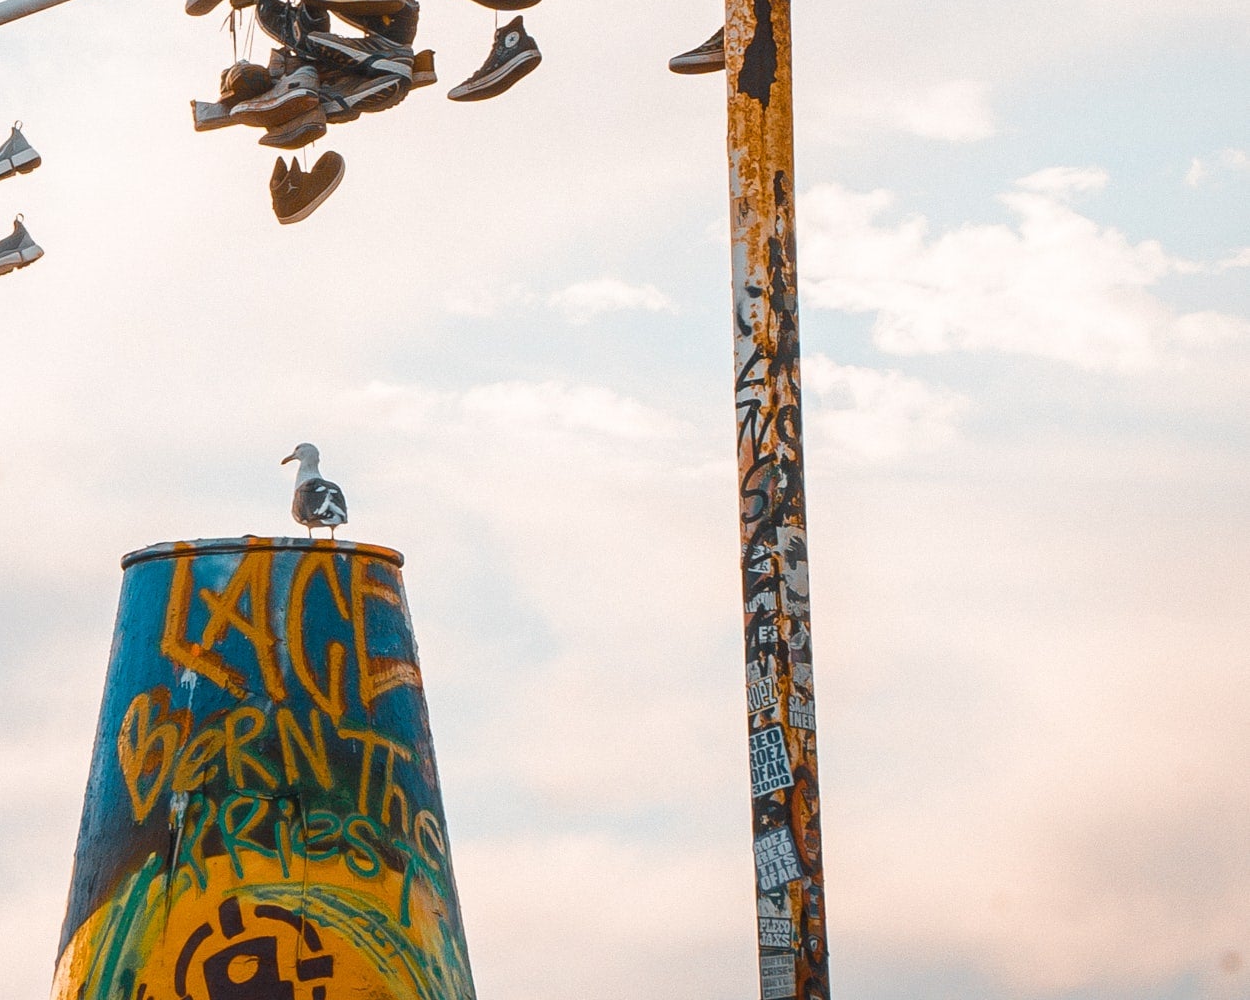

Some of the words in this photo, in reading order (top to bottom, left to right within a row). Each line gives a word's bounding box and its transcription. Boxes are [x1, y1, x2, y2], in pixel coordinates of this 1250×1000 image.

[753, 775, 791, 794] 3000
[756, 841, 792, 866] REO
[760, 863, 801, 890] OFAK
